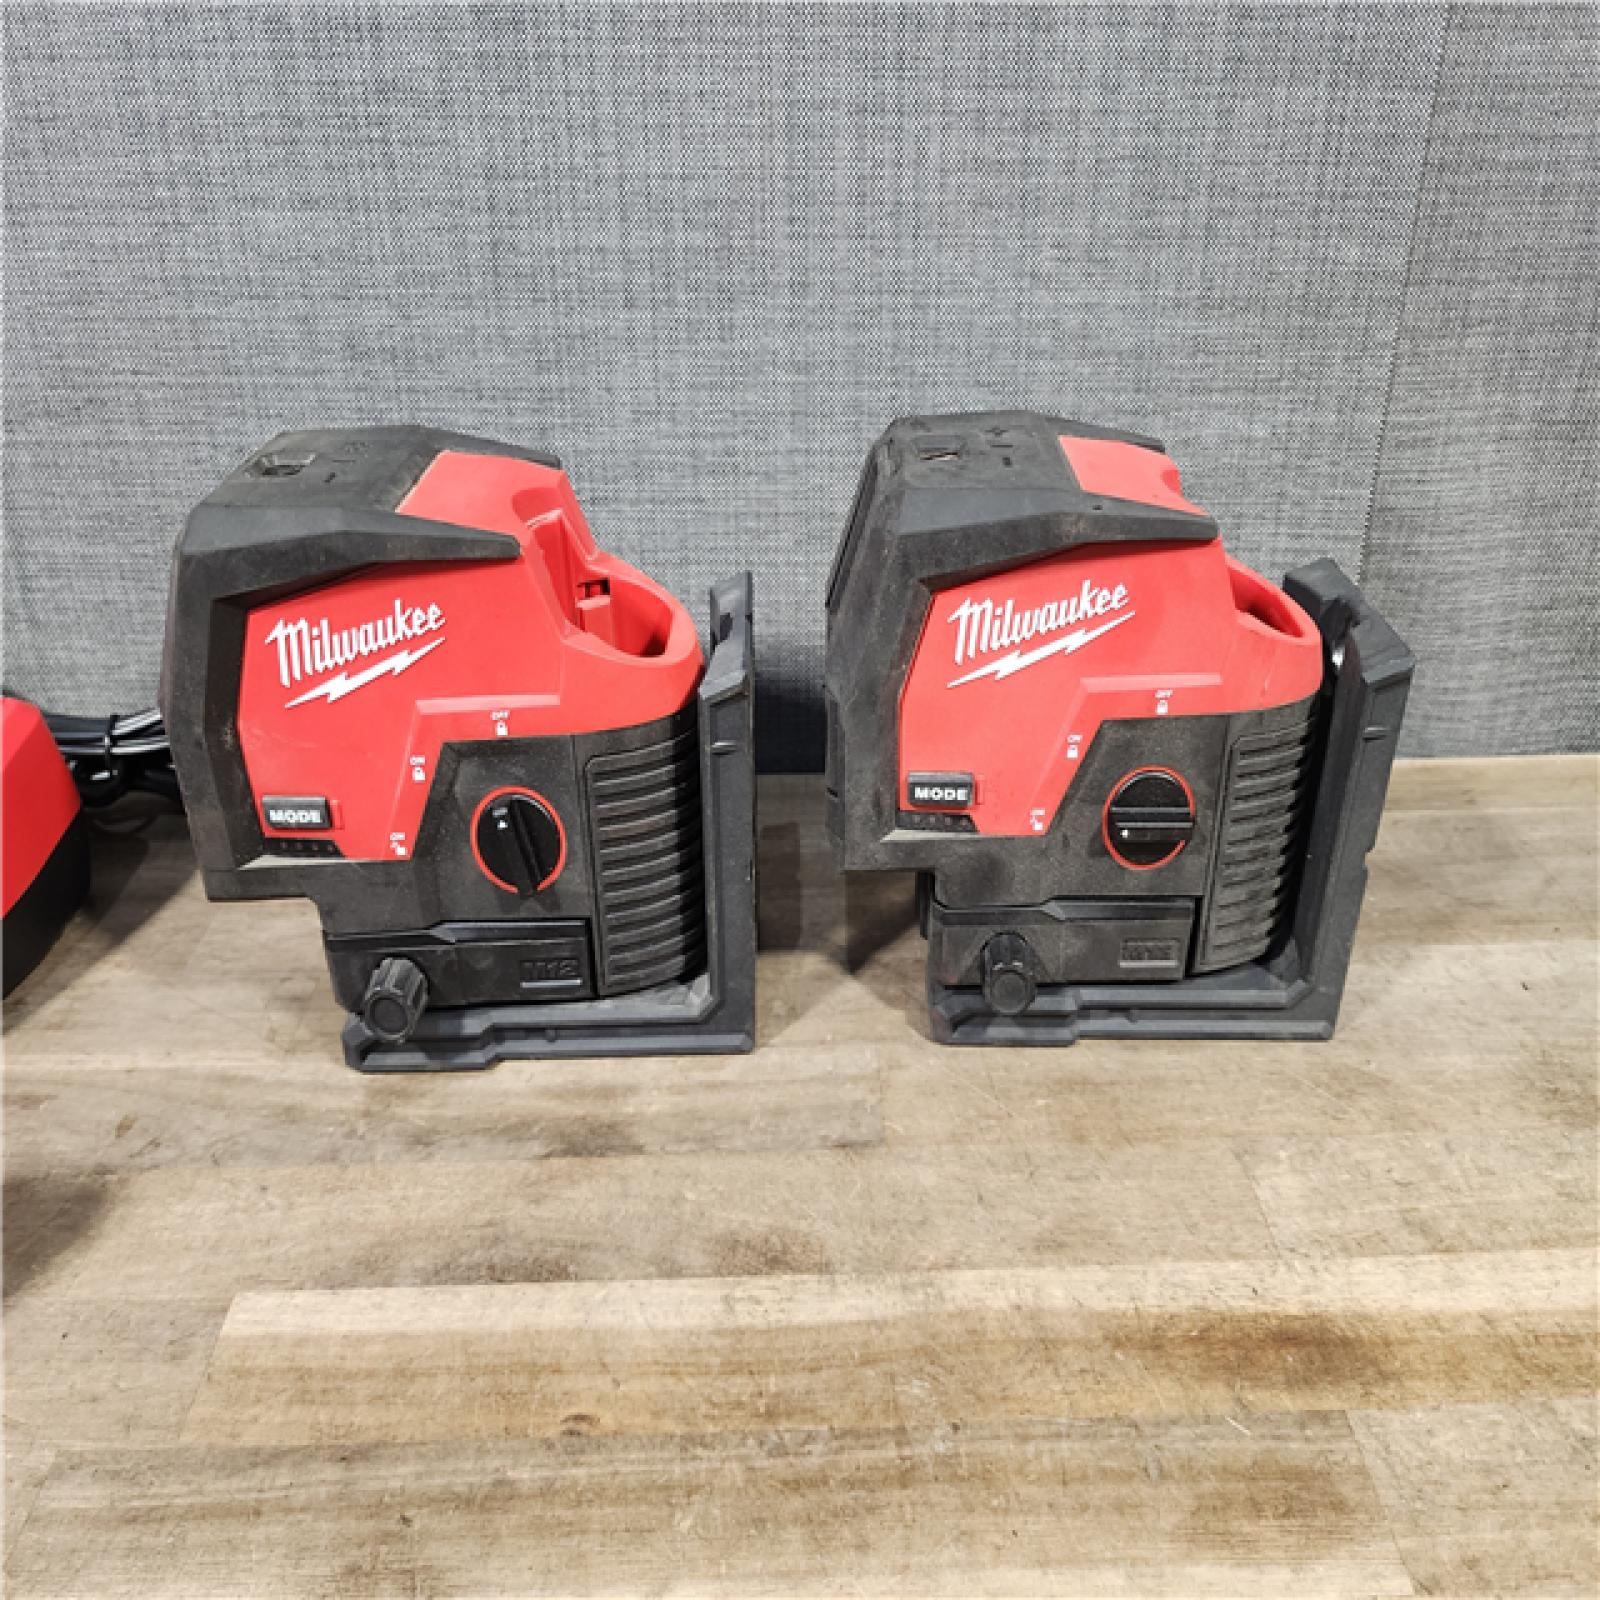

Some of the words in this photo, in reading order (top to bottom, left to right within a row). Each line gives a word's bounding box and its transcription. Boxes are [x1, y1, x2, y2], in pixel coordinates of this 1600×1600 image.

[264, 598, 446, 688] Milwaukee
[947, 579, 1130, 666] Milwaukee
[269, 809, 321, 824] MODE
[914, 786, 968, 802] MODE
